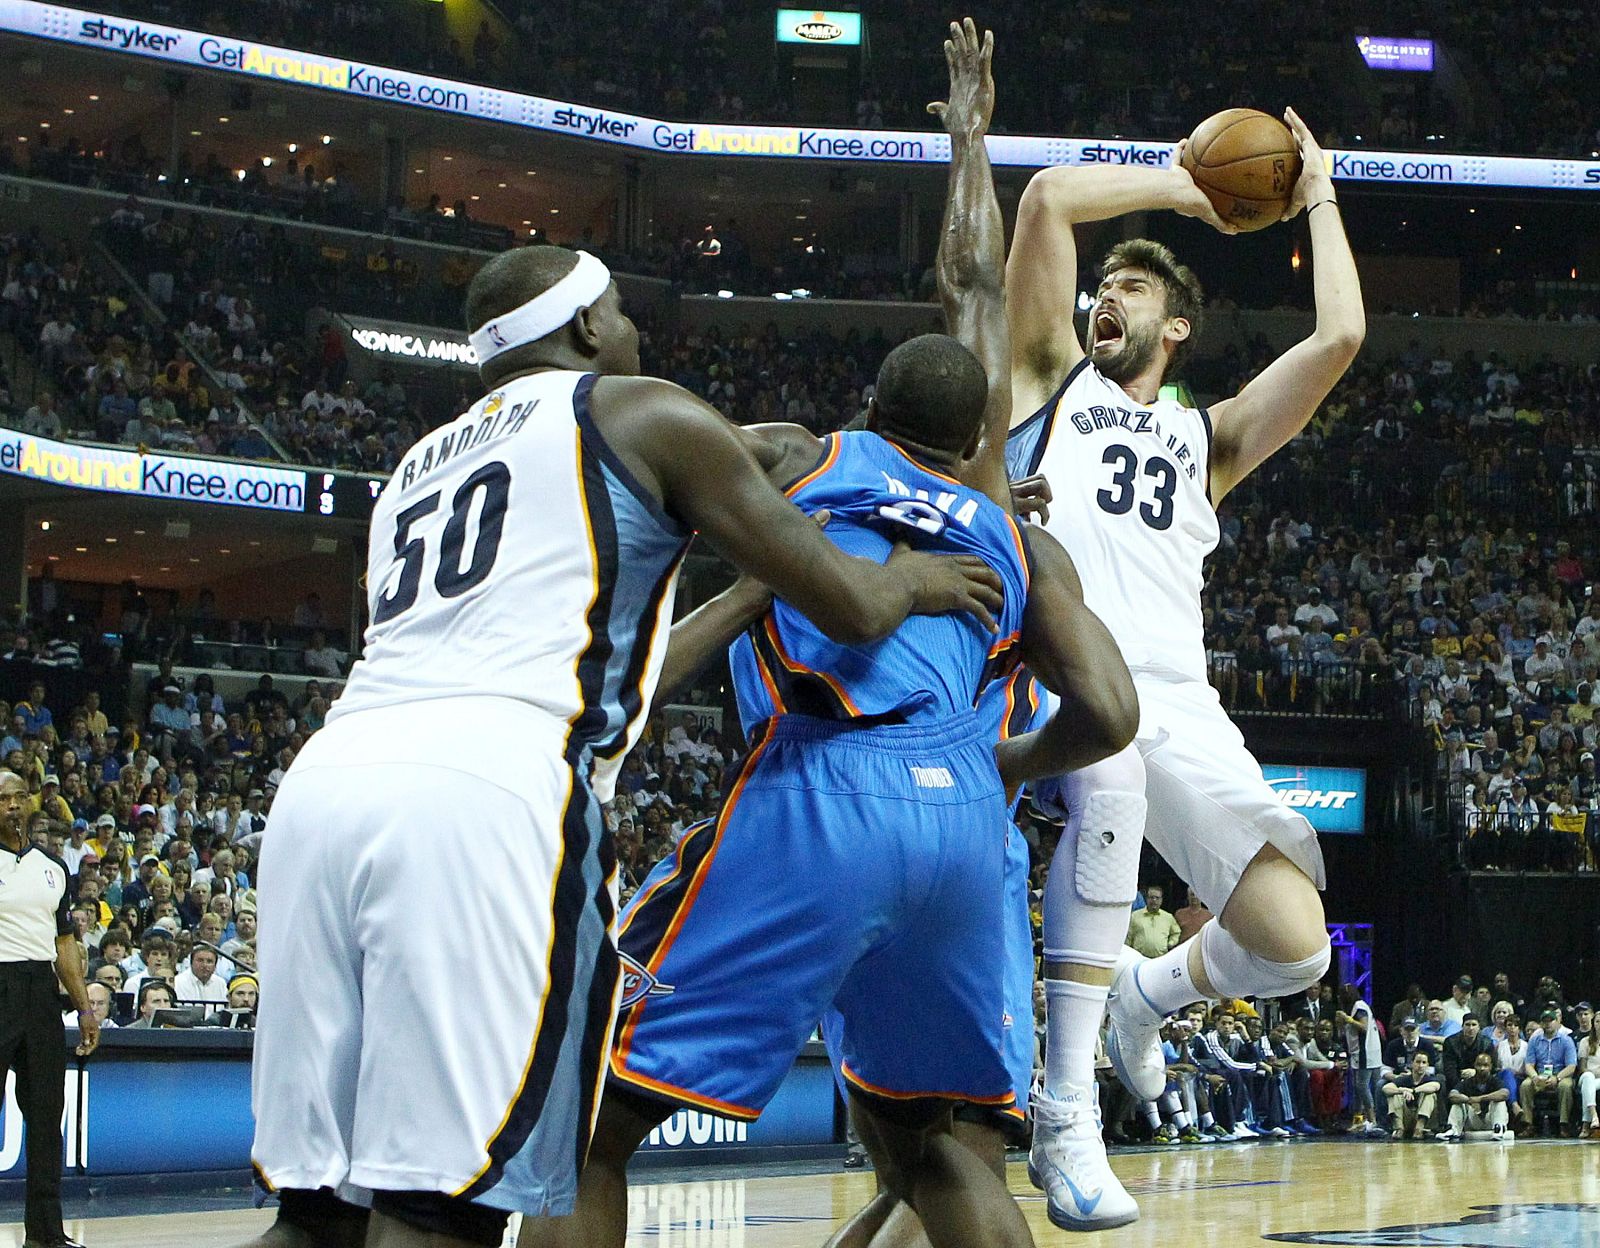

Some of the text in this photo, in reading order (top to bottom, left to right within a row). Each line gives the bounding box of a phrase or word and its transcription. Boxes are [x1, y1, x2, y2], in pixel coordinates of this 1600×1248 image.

[79, 18, 178, 52] stryker
[199, 38, 468, 111] GetAroundKnee.com
[552, 107, 635, 137] stryker
[653, 125, 922, 158] GetAroundKnee.com
[1080, 143, 1170, 165] stryker
[1368, 44, 1430, 56] COVENTRY
[352, 329, 427, 358] KONICA
[0, 440, 302, 507] etAroundKnee.com
[401, 399, 541, 491] RANDOLPH
[1096, 443, 1177, 531] 33
[373, 460, 511, 626] 50
